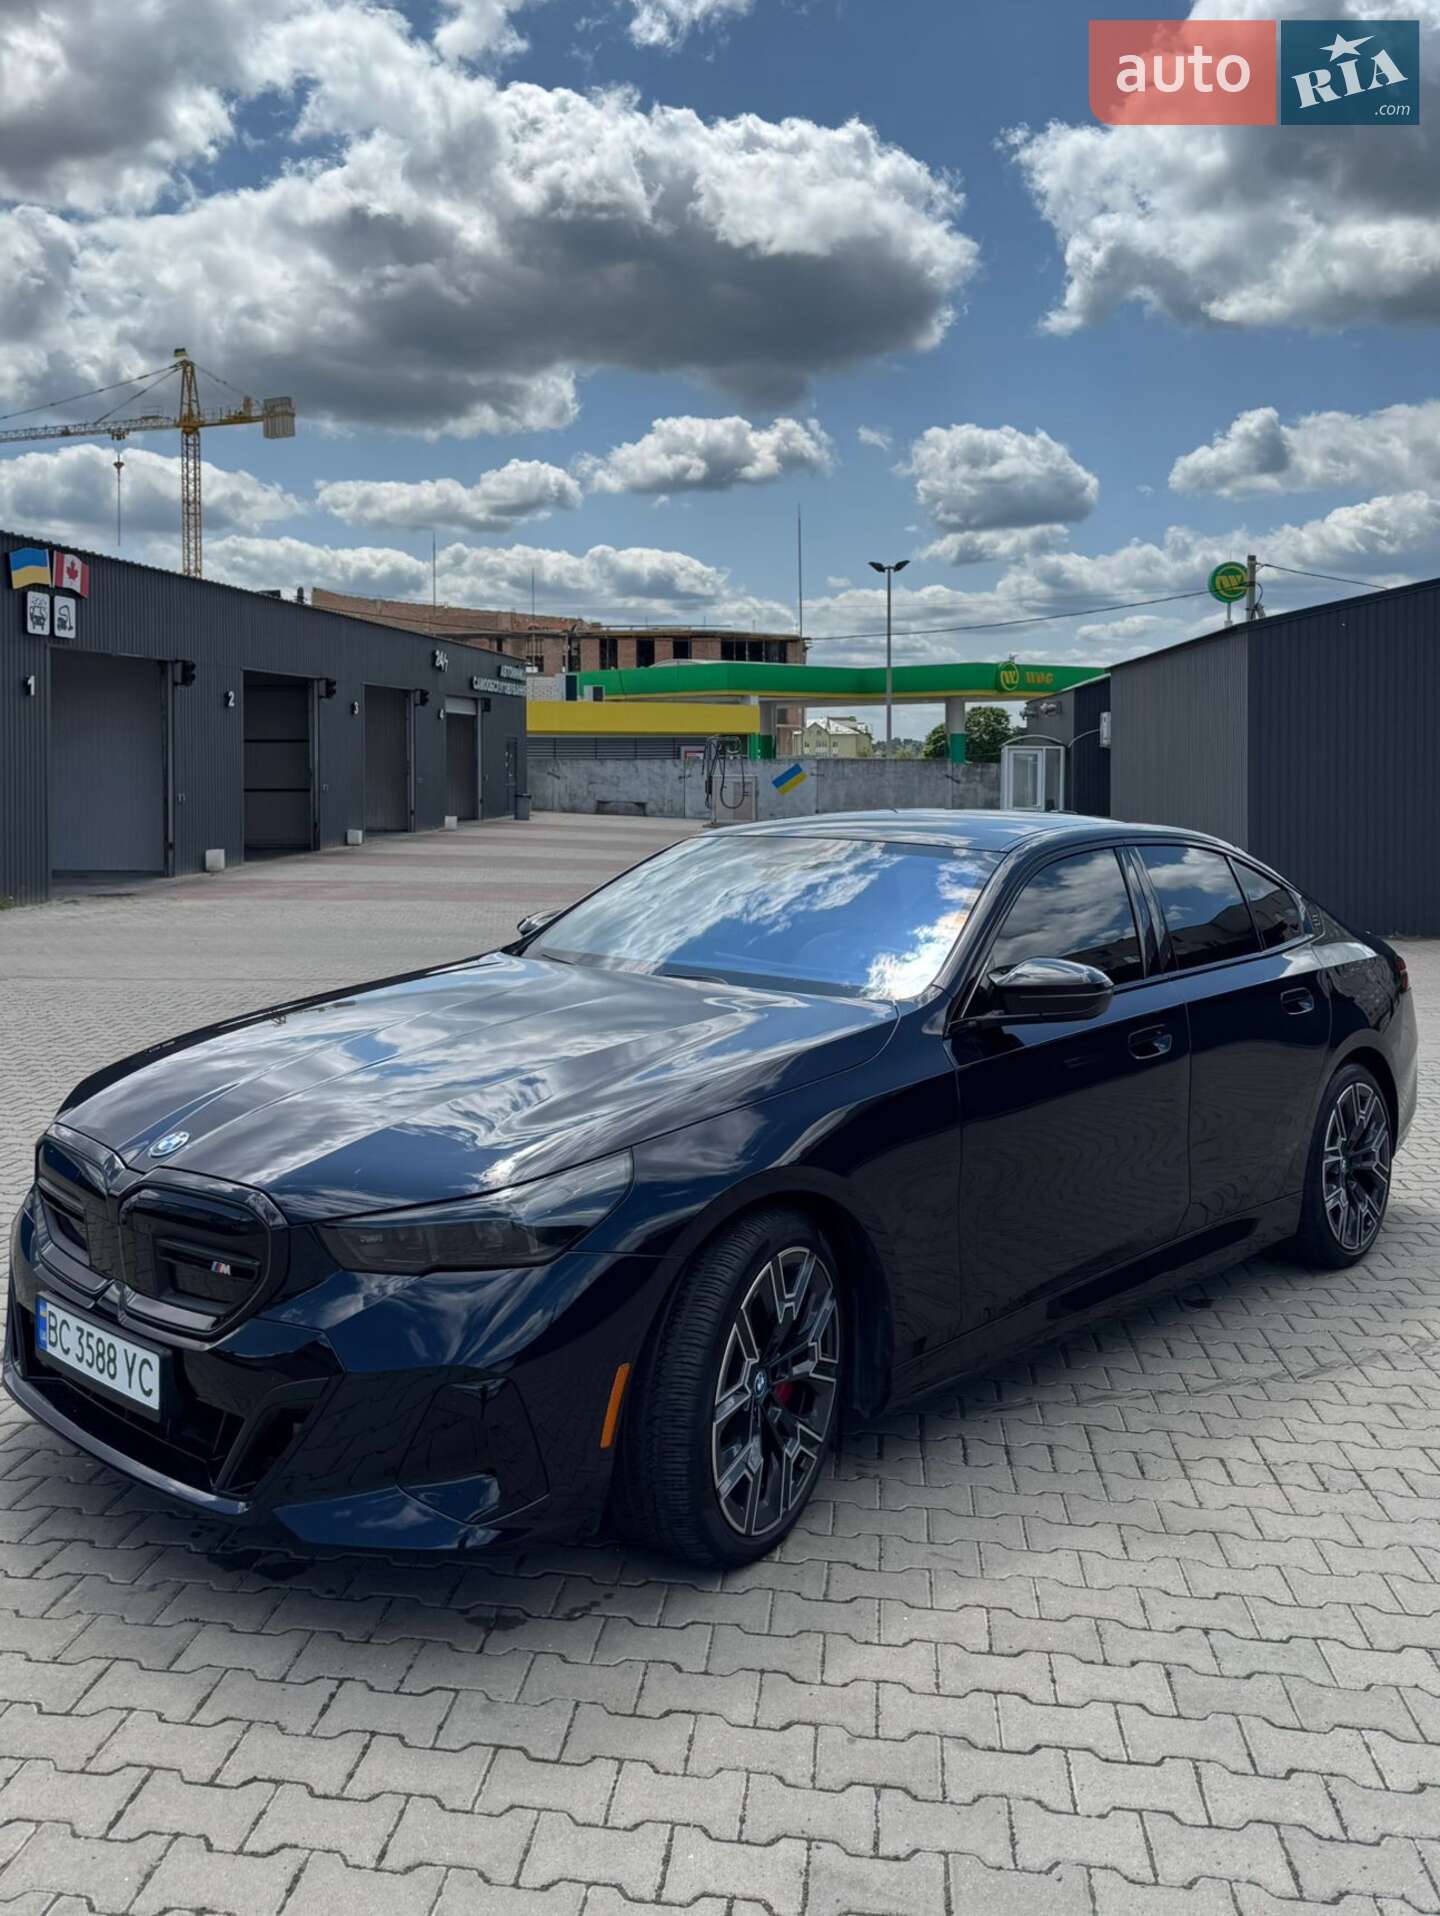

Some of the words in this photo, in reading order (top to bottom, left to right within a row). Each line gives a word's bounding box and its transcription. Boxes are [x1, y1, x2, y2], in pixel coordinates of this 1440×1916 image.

[27, 675, 35, 696] 1
[228, 691, 235, 707] 2
[353, 701, 359, 715] 3
[47, 1310, 71, 1356] BC
[75, 1327, 117, 1380] 3588
[124, 1348, 153, 1398] YC
